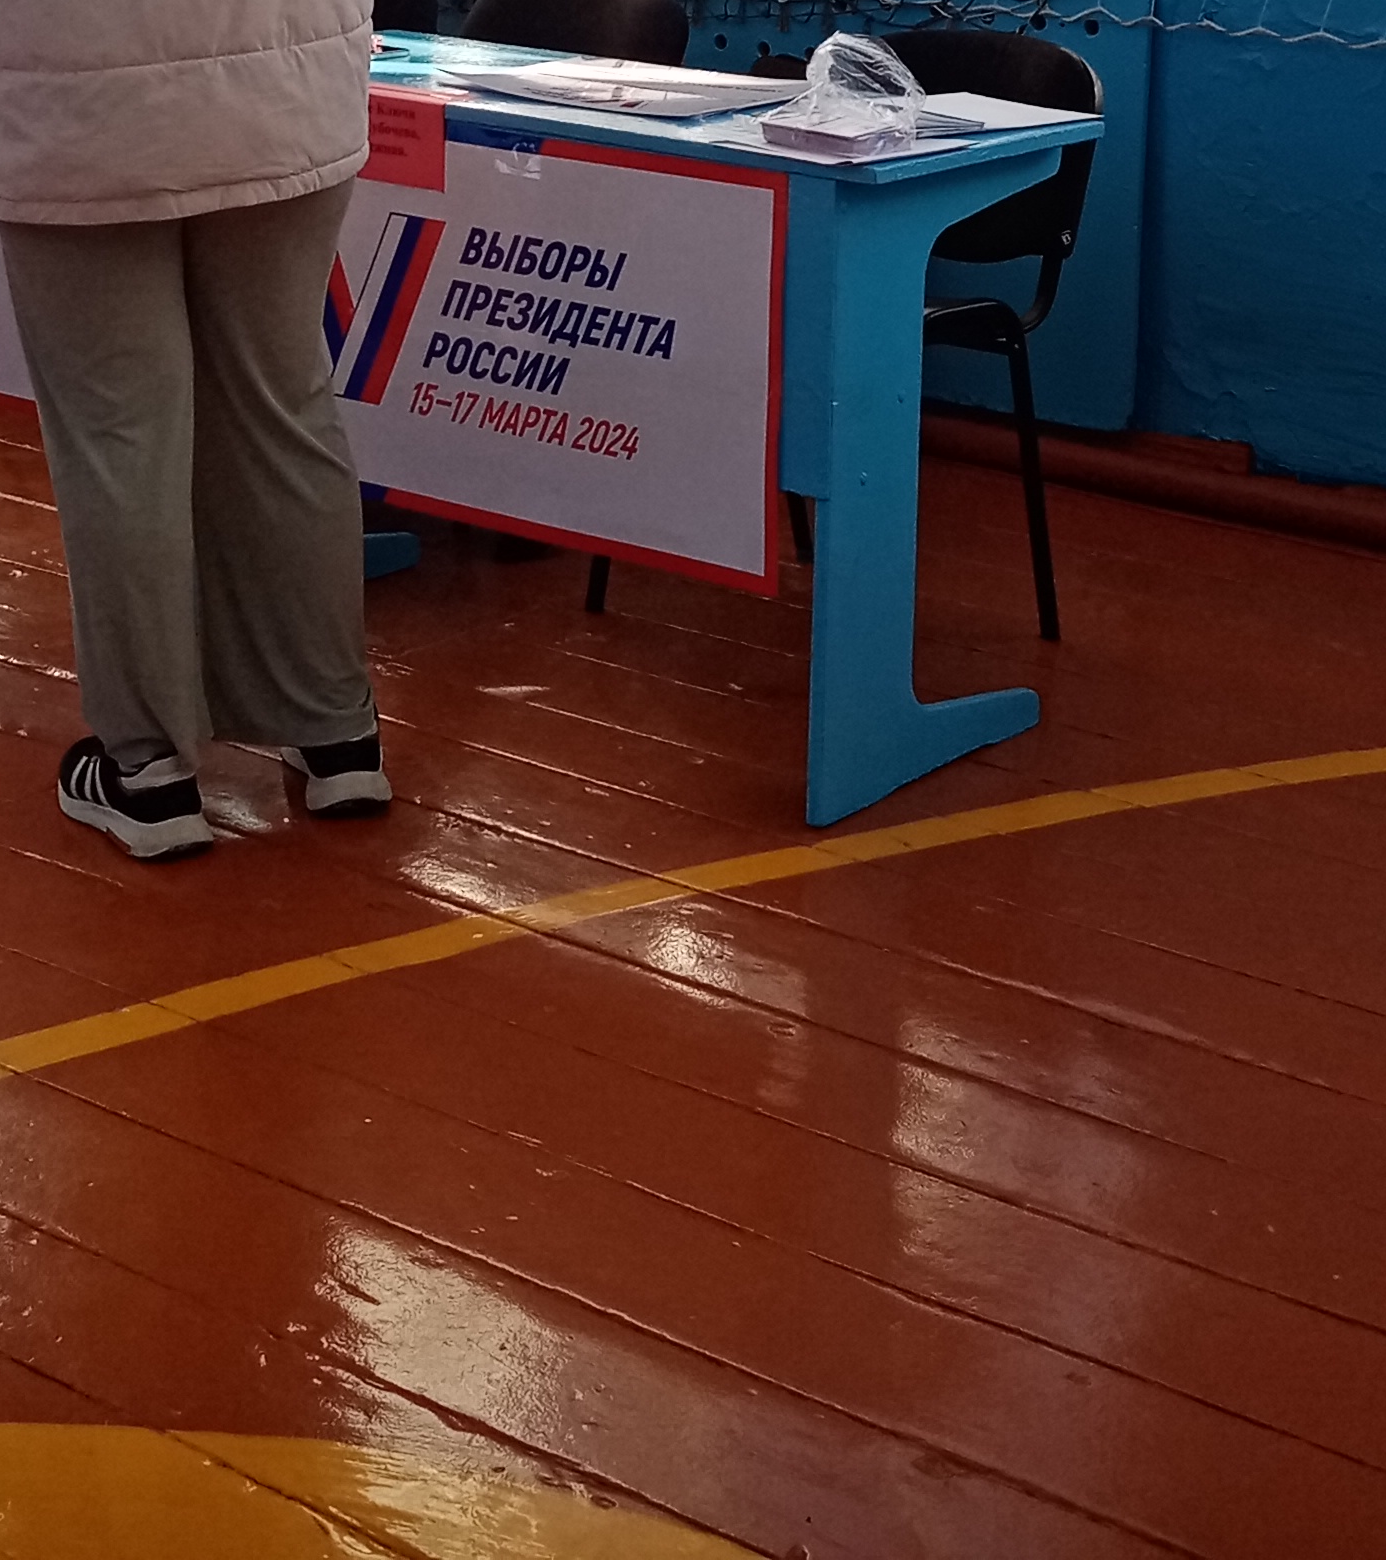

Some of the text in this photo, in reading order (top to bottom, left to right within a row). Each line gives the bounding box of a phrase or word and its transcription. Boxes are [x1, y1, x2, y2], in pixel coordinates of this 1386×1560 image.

[459, 227, 628, 292] ВЫБОРЫ
[440, 279, 677, 360] ПРЕЗИДЕНТА
[422, 331, 571, 396] РОССИИ
[409, 382, 641, 461] 15–17 МАРТА 2024
